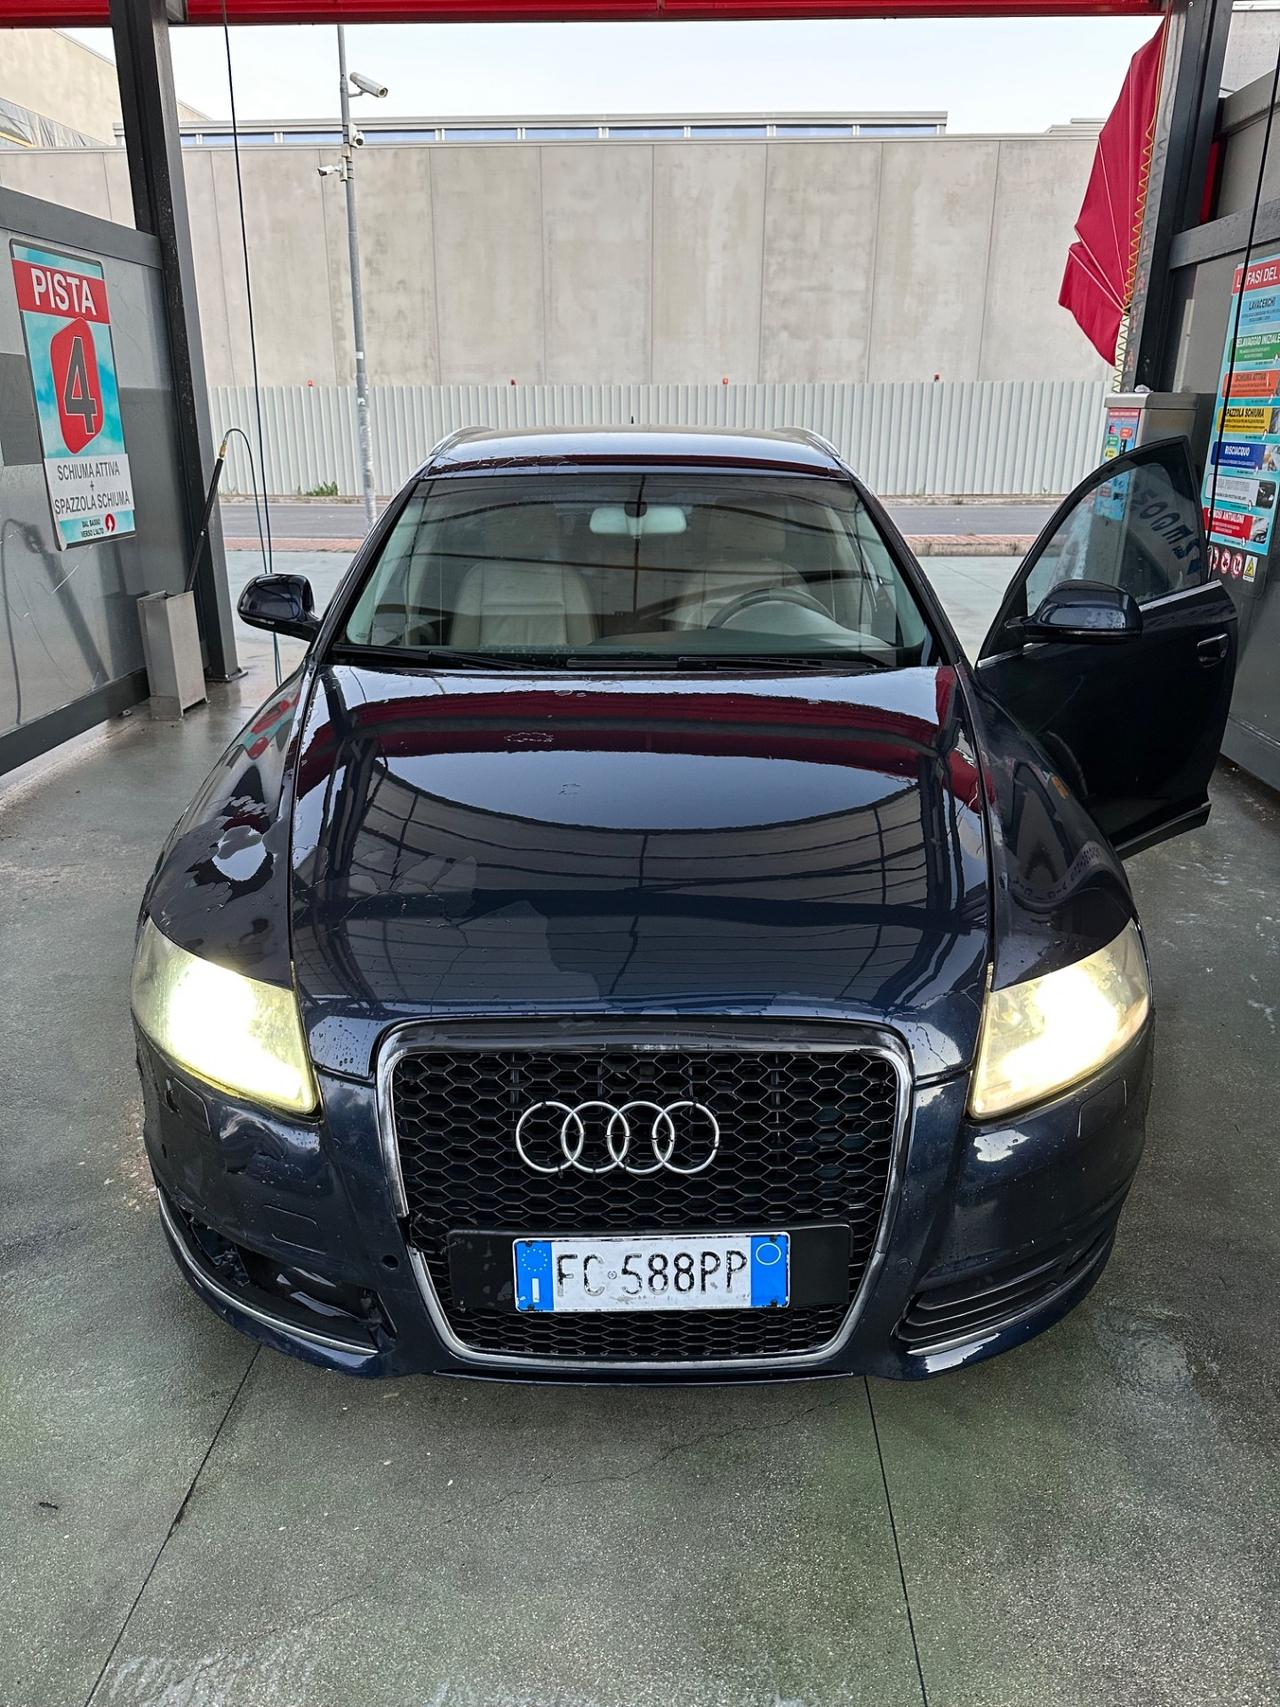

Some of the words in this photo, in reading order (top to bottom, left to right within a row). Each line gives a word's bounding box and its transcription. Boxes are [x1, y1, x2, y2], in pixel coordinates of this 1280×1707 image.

[30, 267, 97, 316] PISTA
[1247, 270, 1263, 286] FASI
[1263, 266, 1278, 281] DEL
[62, 336, 98, 435] 4
[57, 463, 95, 481] SCHIUMA
[95, 461, 120, 477] ATTIVA
[54, 495, 97, 515] SPAZZOLA
[97, 490, 131, 509] SCHIUMA
[556, 1253, 606, 1297] FC
[620, 1250, 748, 1295] 588PP
